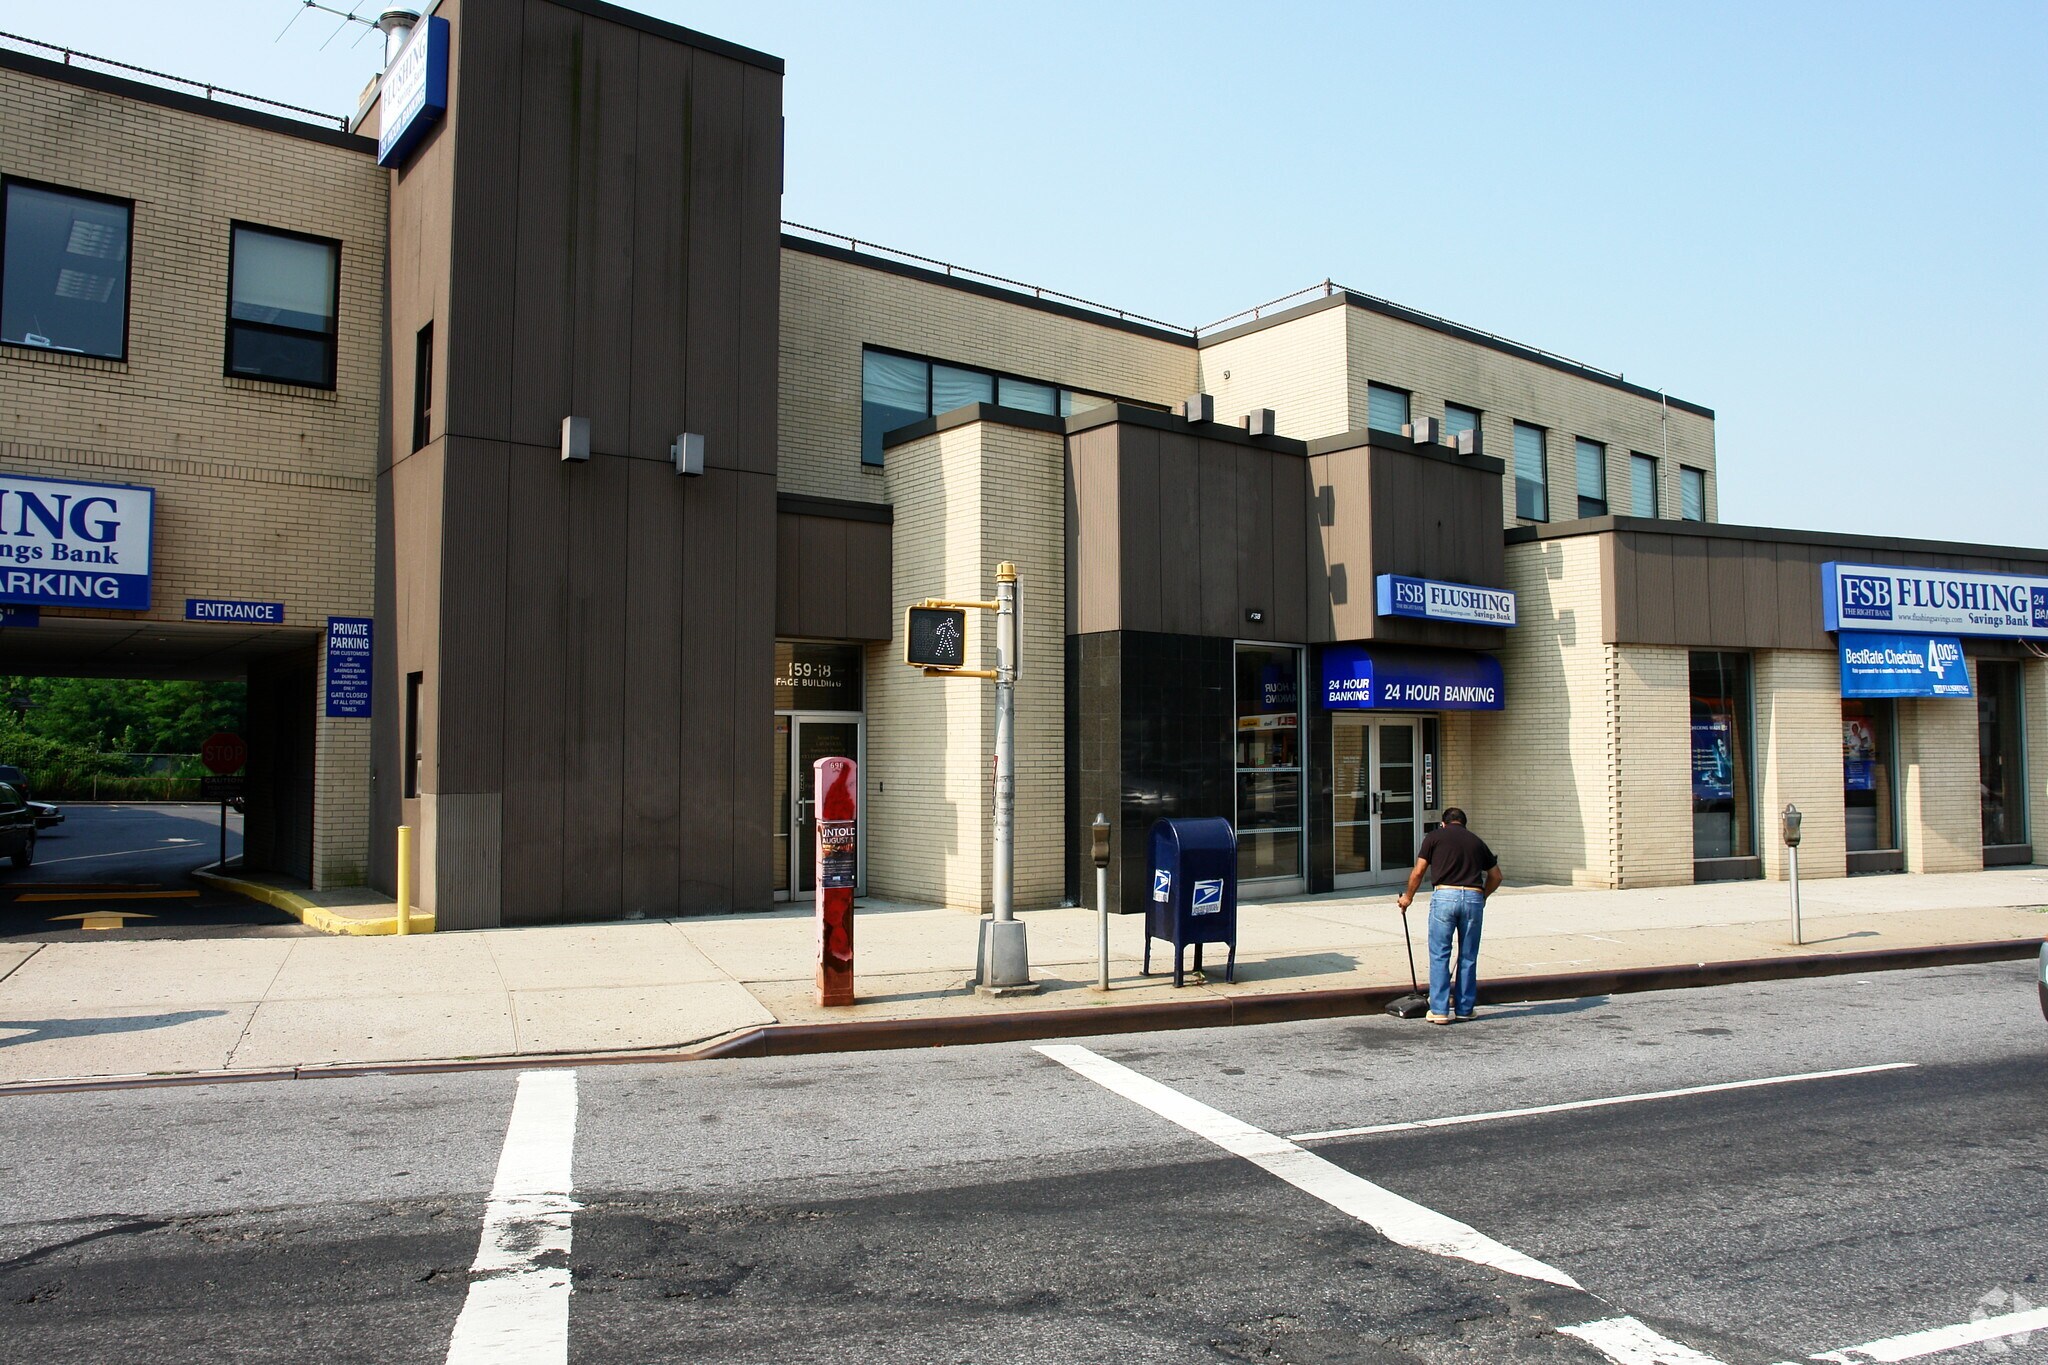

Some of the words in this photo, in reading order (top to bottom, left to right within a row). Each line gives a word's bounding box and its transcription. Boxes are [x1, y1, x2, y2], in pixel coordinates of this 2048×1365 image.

[384, 33, 426, 112] FLUSHING
[51, 543, 119, 565] Bank
[1395, 582, 1424, 604] FSB
[1430, 587, 1510, 613] FLUSHING
[1843, 578, 1891, 607] FSB
[1896, 578, 2029, 613] FLUSHING
[2033, 594, 2044, 606] 24
[196, 602, 274, 619] ENTRANCE
[1474, 609, 1495, 621] Savings
[1496, 612, 1511, 621] Bank
[1844, 608, 1856, 616] THE
[1856, 609, 1874, 617] RIGHT
[1874, 610, 1891, 618] BANK
[1968, 613, 2003, 628] Savings
[2005, 614, 2029, 626] Bank
[333, 622, 368, 635] PRIVATE
[330, 637, 369, 650] PARKING
[1845, 648, 1884, 664] BestRate
[1885, 649, 1924, 668] Checking
[788, 662, 831, 677] 159-18
[802, 678, 842, 688] BUILDING
[1328, 680, 1340, 690] 24
[1343, 679, 1369, 690] HOUR
[1328, 690, 1369, 702] BANKING
[1385, 683, 1400, 700] 24
[1405, 684, 1440, 701] HOUR
[1444, 685, 1495, 703] BANKING
[207, 745, 242, 761] STOP
